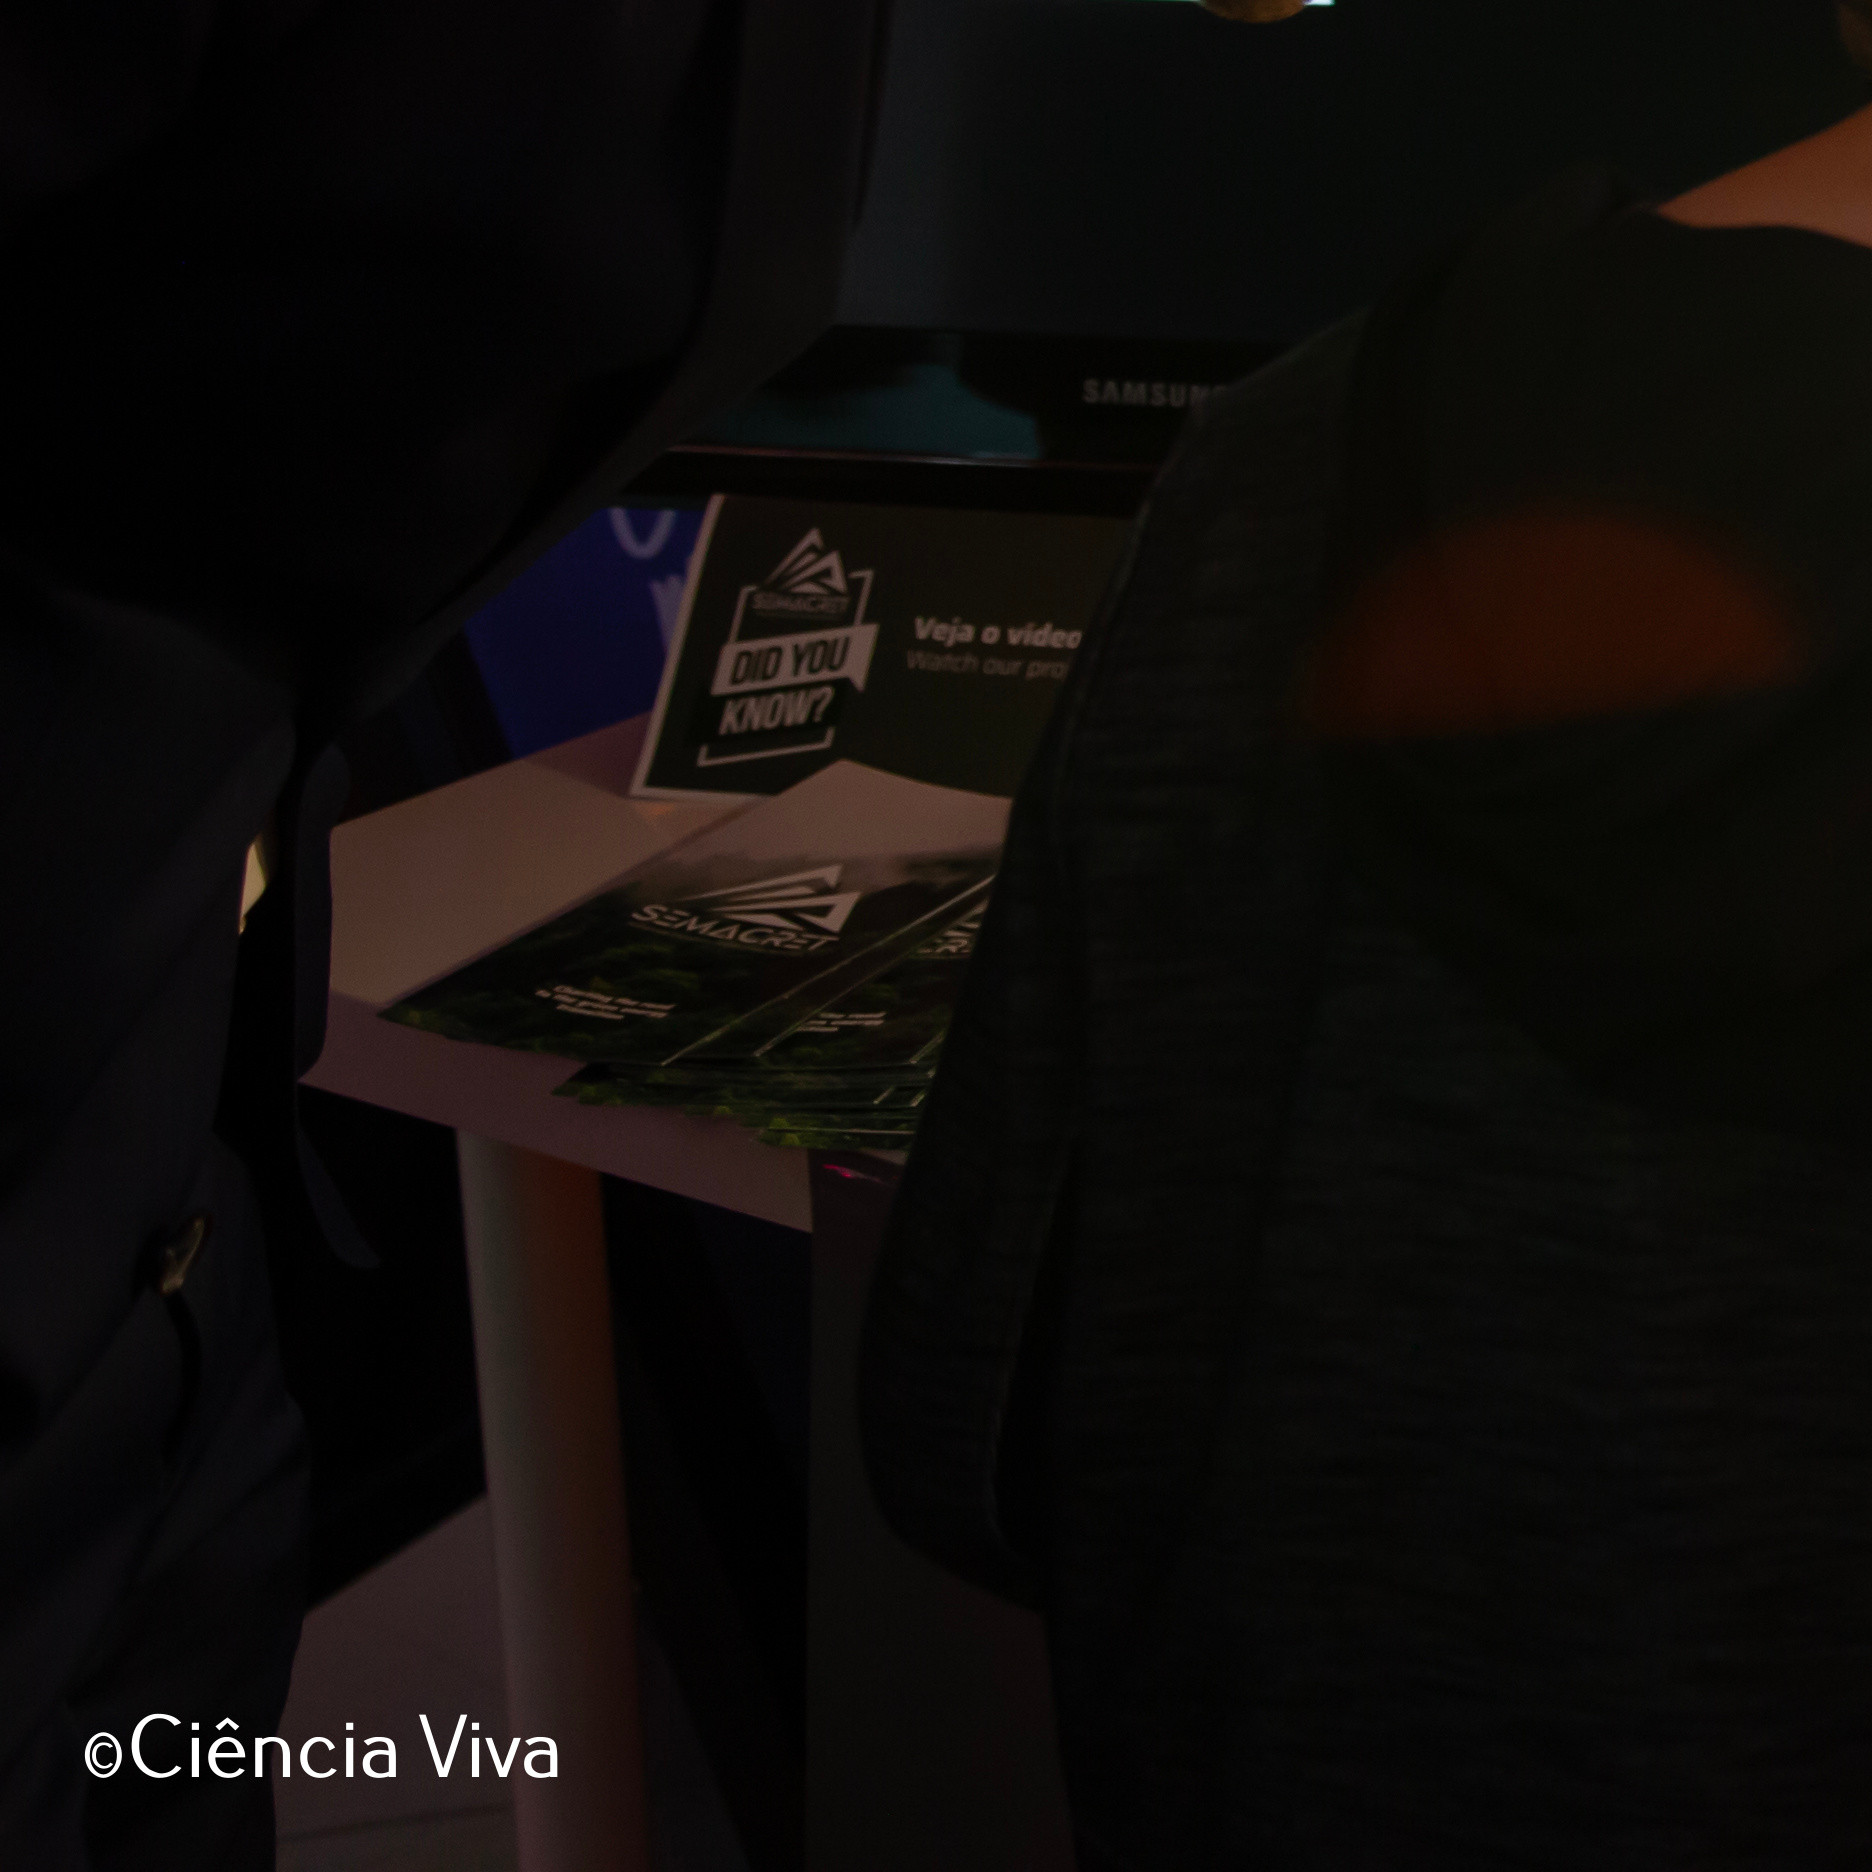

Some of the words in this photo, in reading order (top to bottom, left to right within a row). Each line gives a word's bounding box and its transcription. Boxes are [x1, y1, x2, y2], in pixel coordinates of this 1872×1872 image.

[1081, 377, 1226, 408] SAMSUN
[915, 616, 976, 648] Veja
[980, 625, 1001, 646] o
[730, 647, 782, 686] DID
[793, 635, 849, 677] YOU
[907, 649, 980, 674] Watch
[982, 658, 1022, 677] our
[718, 685, 835, 736] KNOW?
[630, 903, 842, 951] SEMACRET
